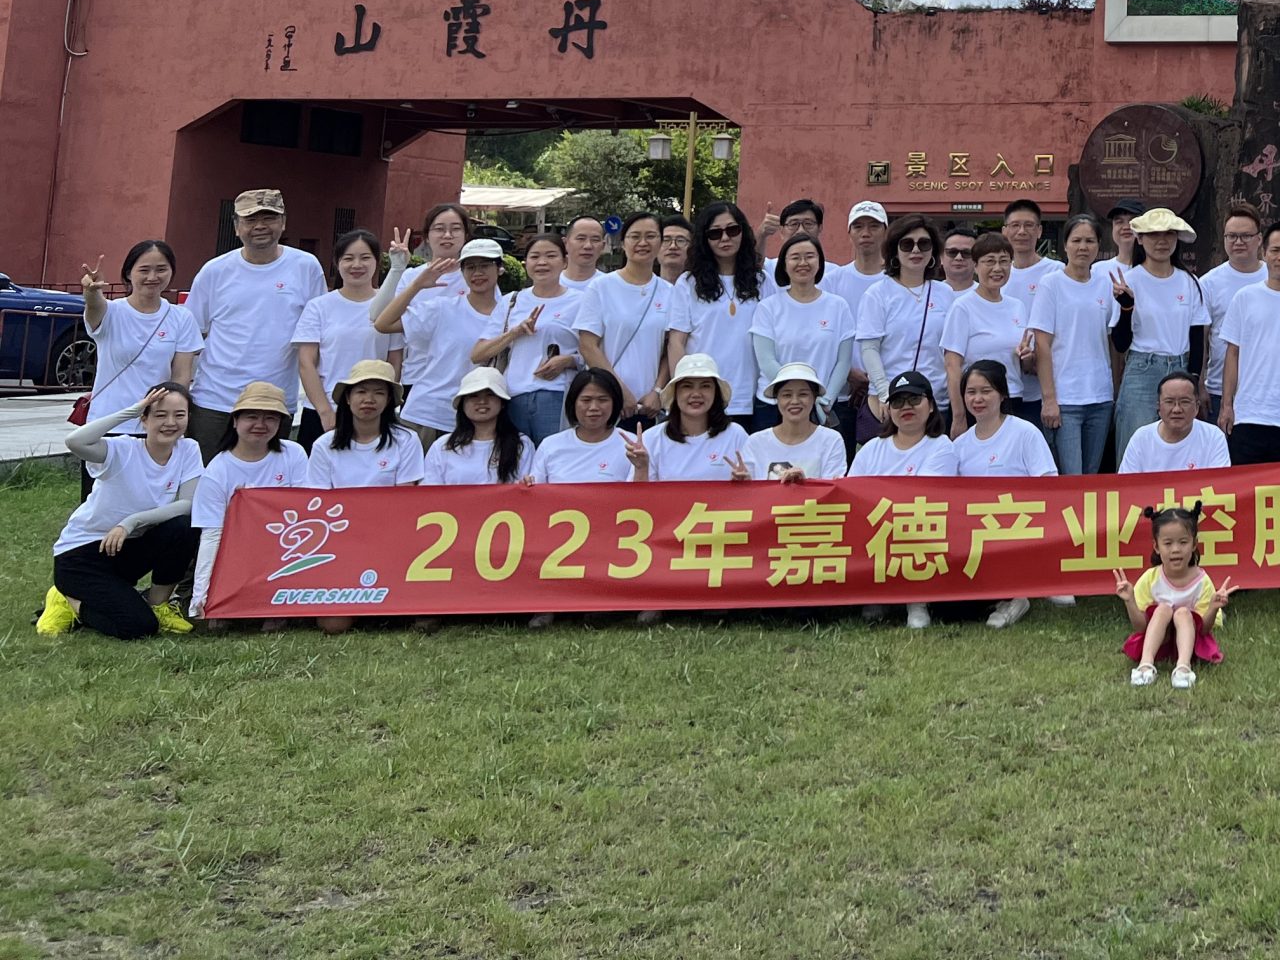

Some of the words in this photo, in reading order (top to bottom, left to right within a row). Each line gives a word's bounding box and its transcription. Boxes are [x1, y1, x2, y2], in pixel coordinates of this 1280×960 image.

[905, 151, 1054, 178] 景区入口
[909, 181, 949, 191] SCENIC
[954, 181, 984, 191] SPOT
[989, 181, 1051, 191] ENTRANCE
[272, 589, 388, 604] EVERSHINE
